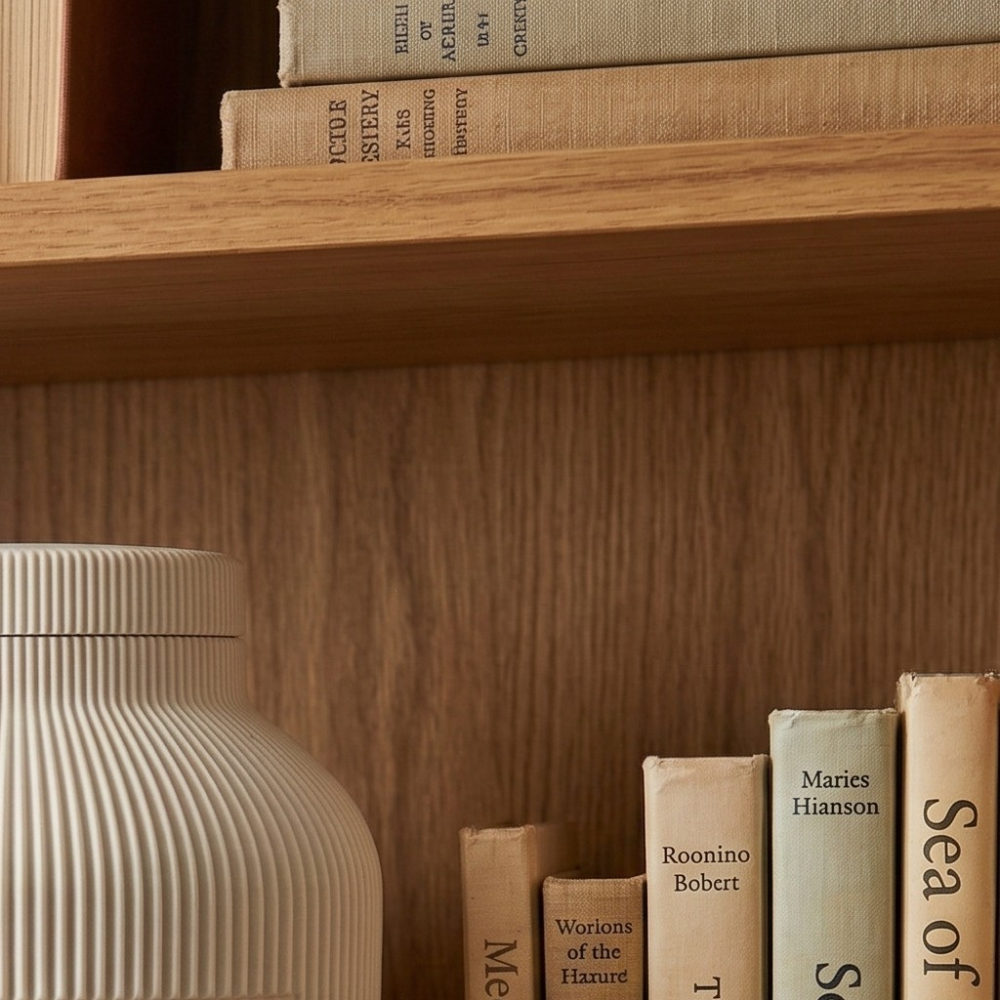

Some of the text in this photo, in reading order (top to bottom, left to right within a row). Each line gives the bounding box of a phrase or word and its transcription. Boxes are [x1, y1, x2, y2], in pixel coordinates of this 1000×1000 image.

[801, 769, 870, 789] Maries
[792, 797, 880, 816] Hianson
[662, 845, 751, 865] Roonino
[923, 798, 979, 901] Sea
[673, 873, 740, 892] Bobert
[567, 943, 621, 960] of the
[921, 920, 981, 987] of
